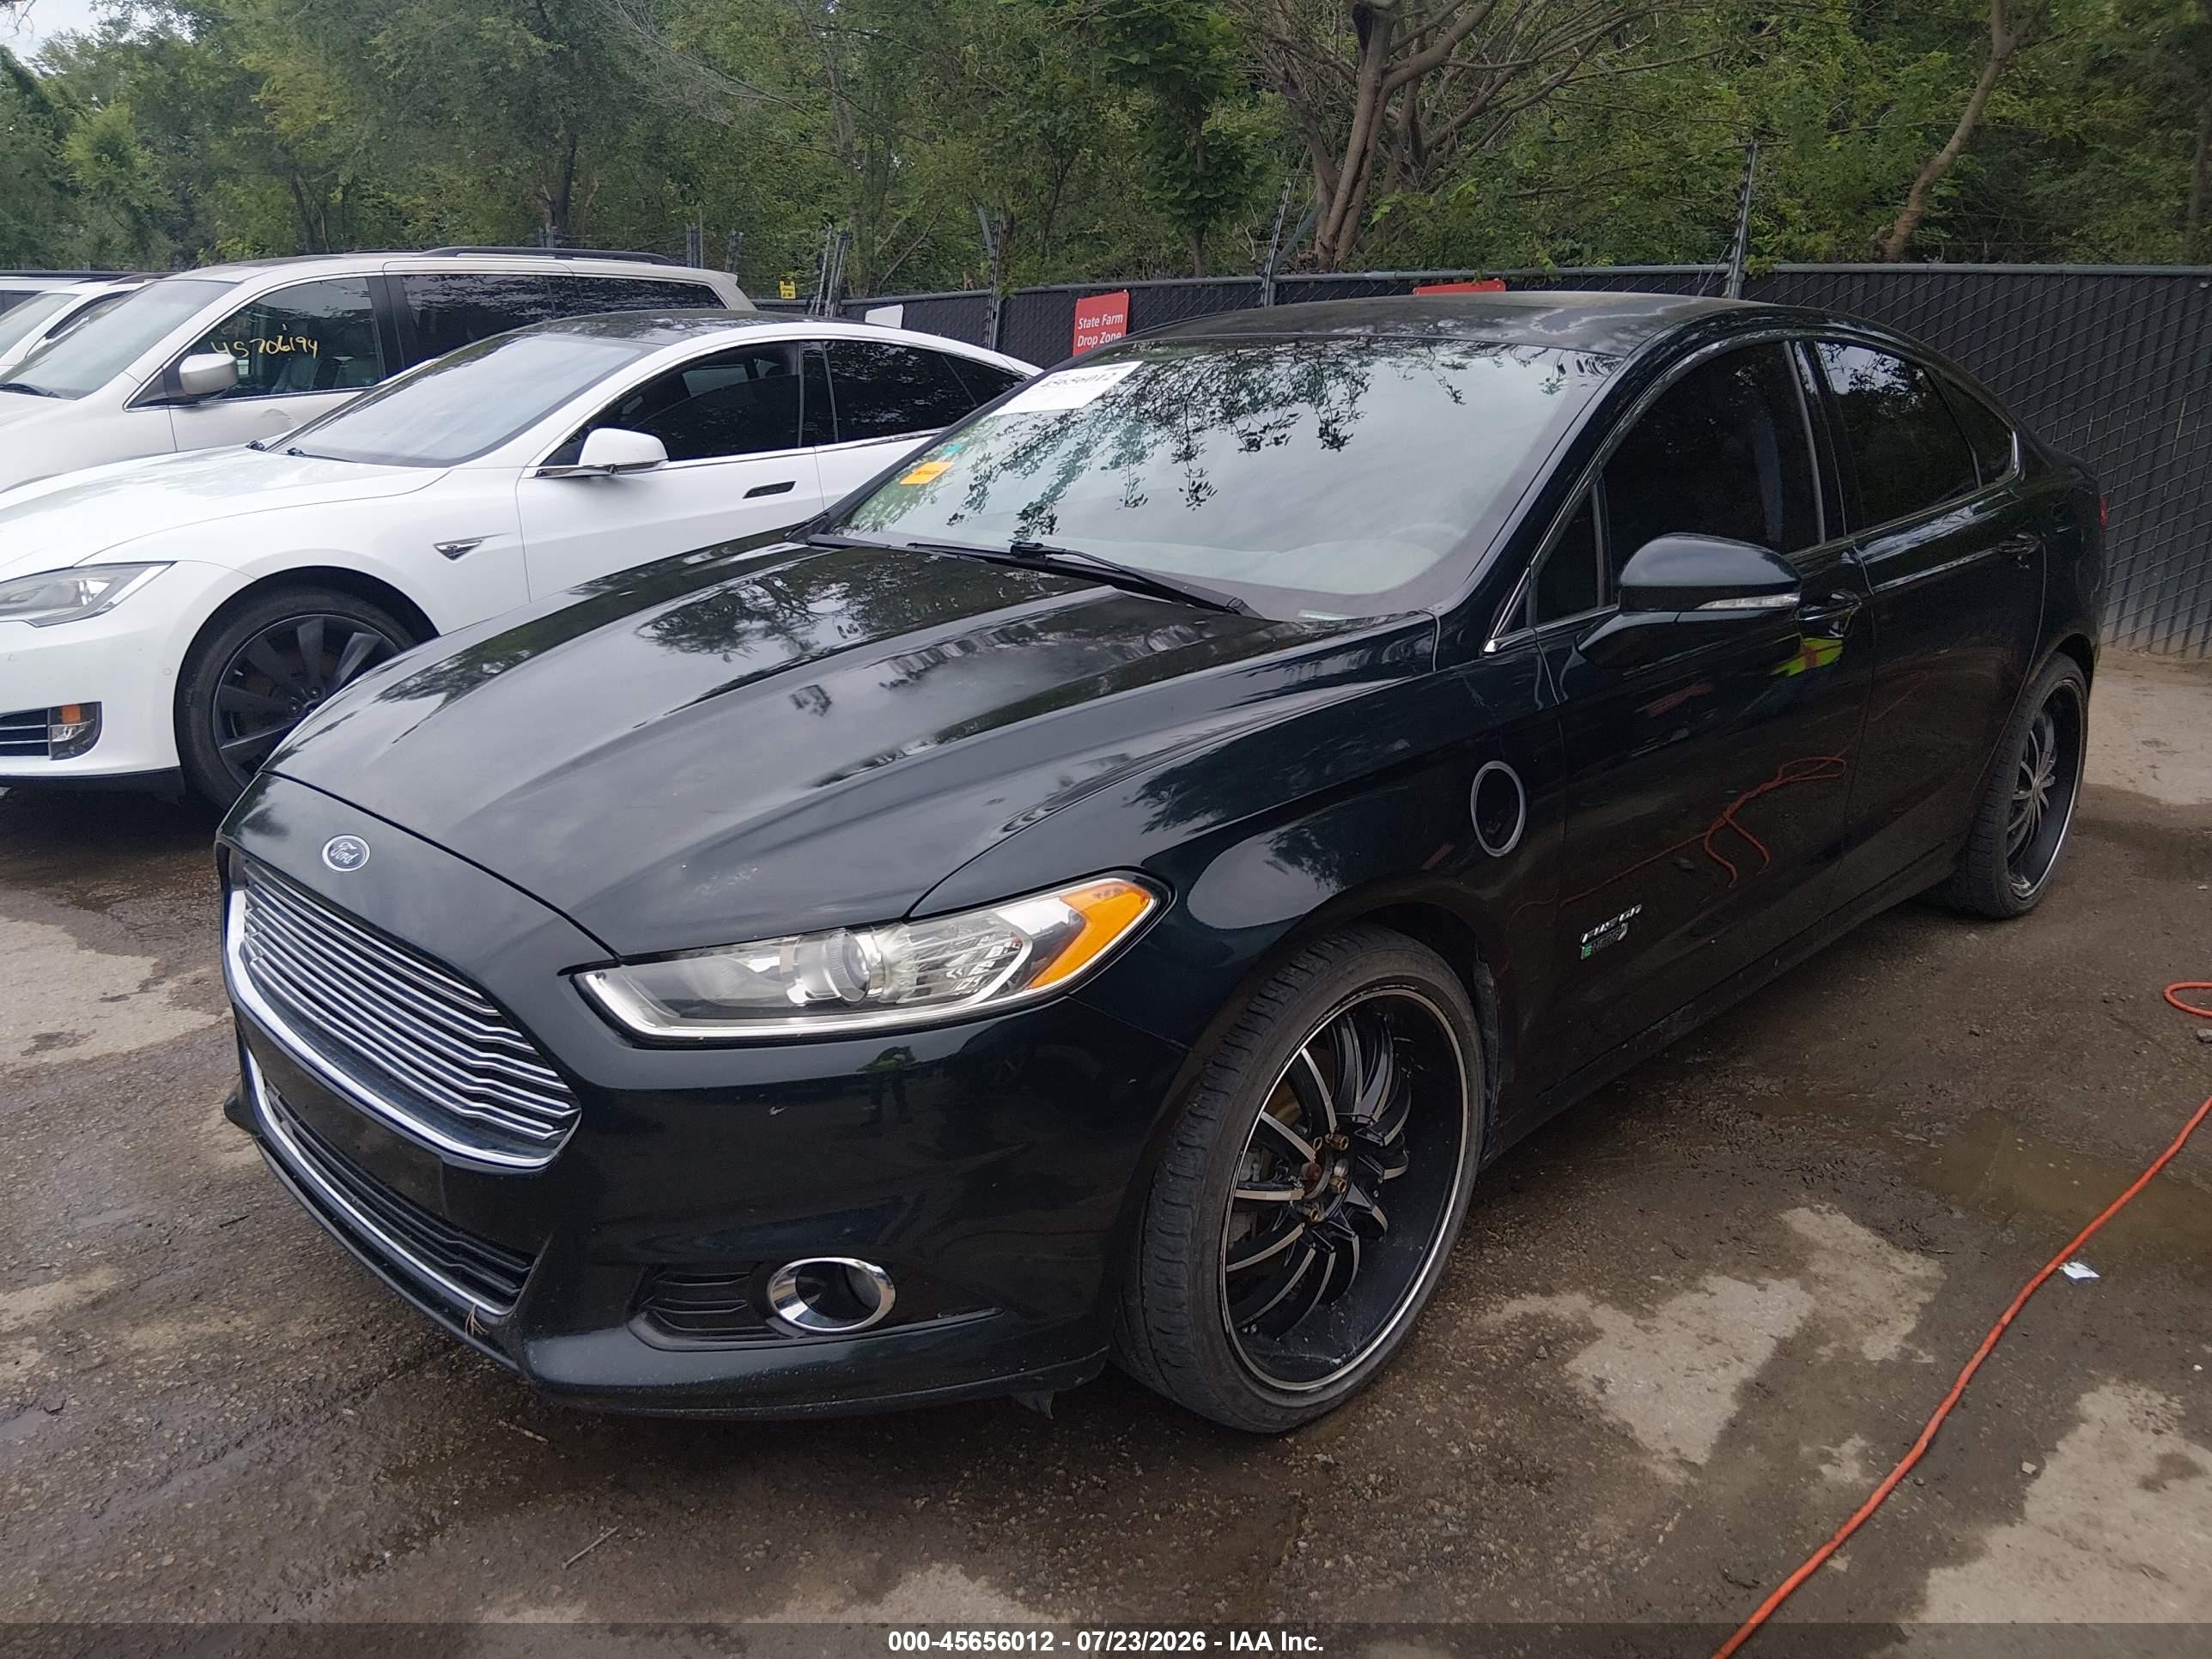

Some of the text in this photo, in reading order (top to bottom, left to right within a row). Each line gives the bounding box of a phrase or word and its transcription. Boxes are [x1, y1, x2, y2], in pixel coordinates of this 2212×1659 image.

[1078, 313, 1123, 331] State Farm
[1077, 331, 1122, 348] Drop Zone
[330, 841, 360, 865] Ford
